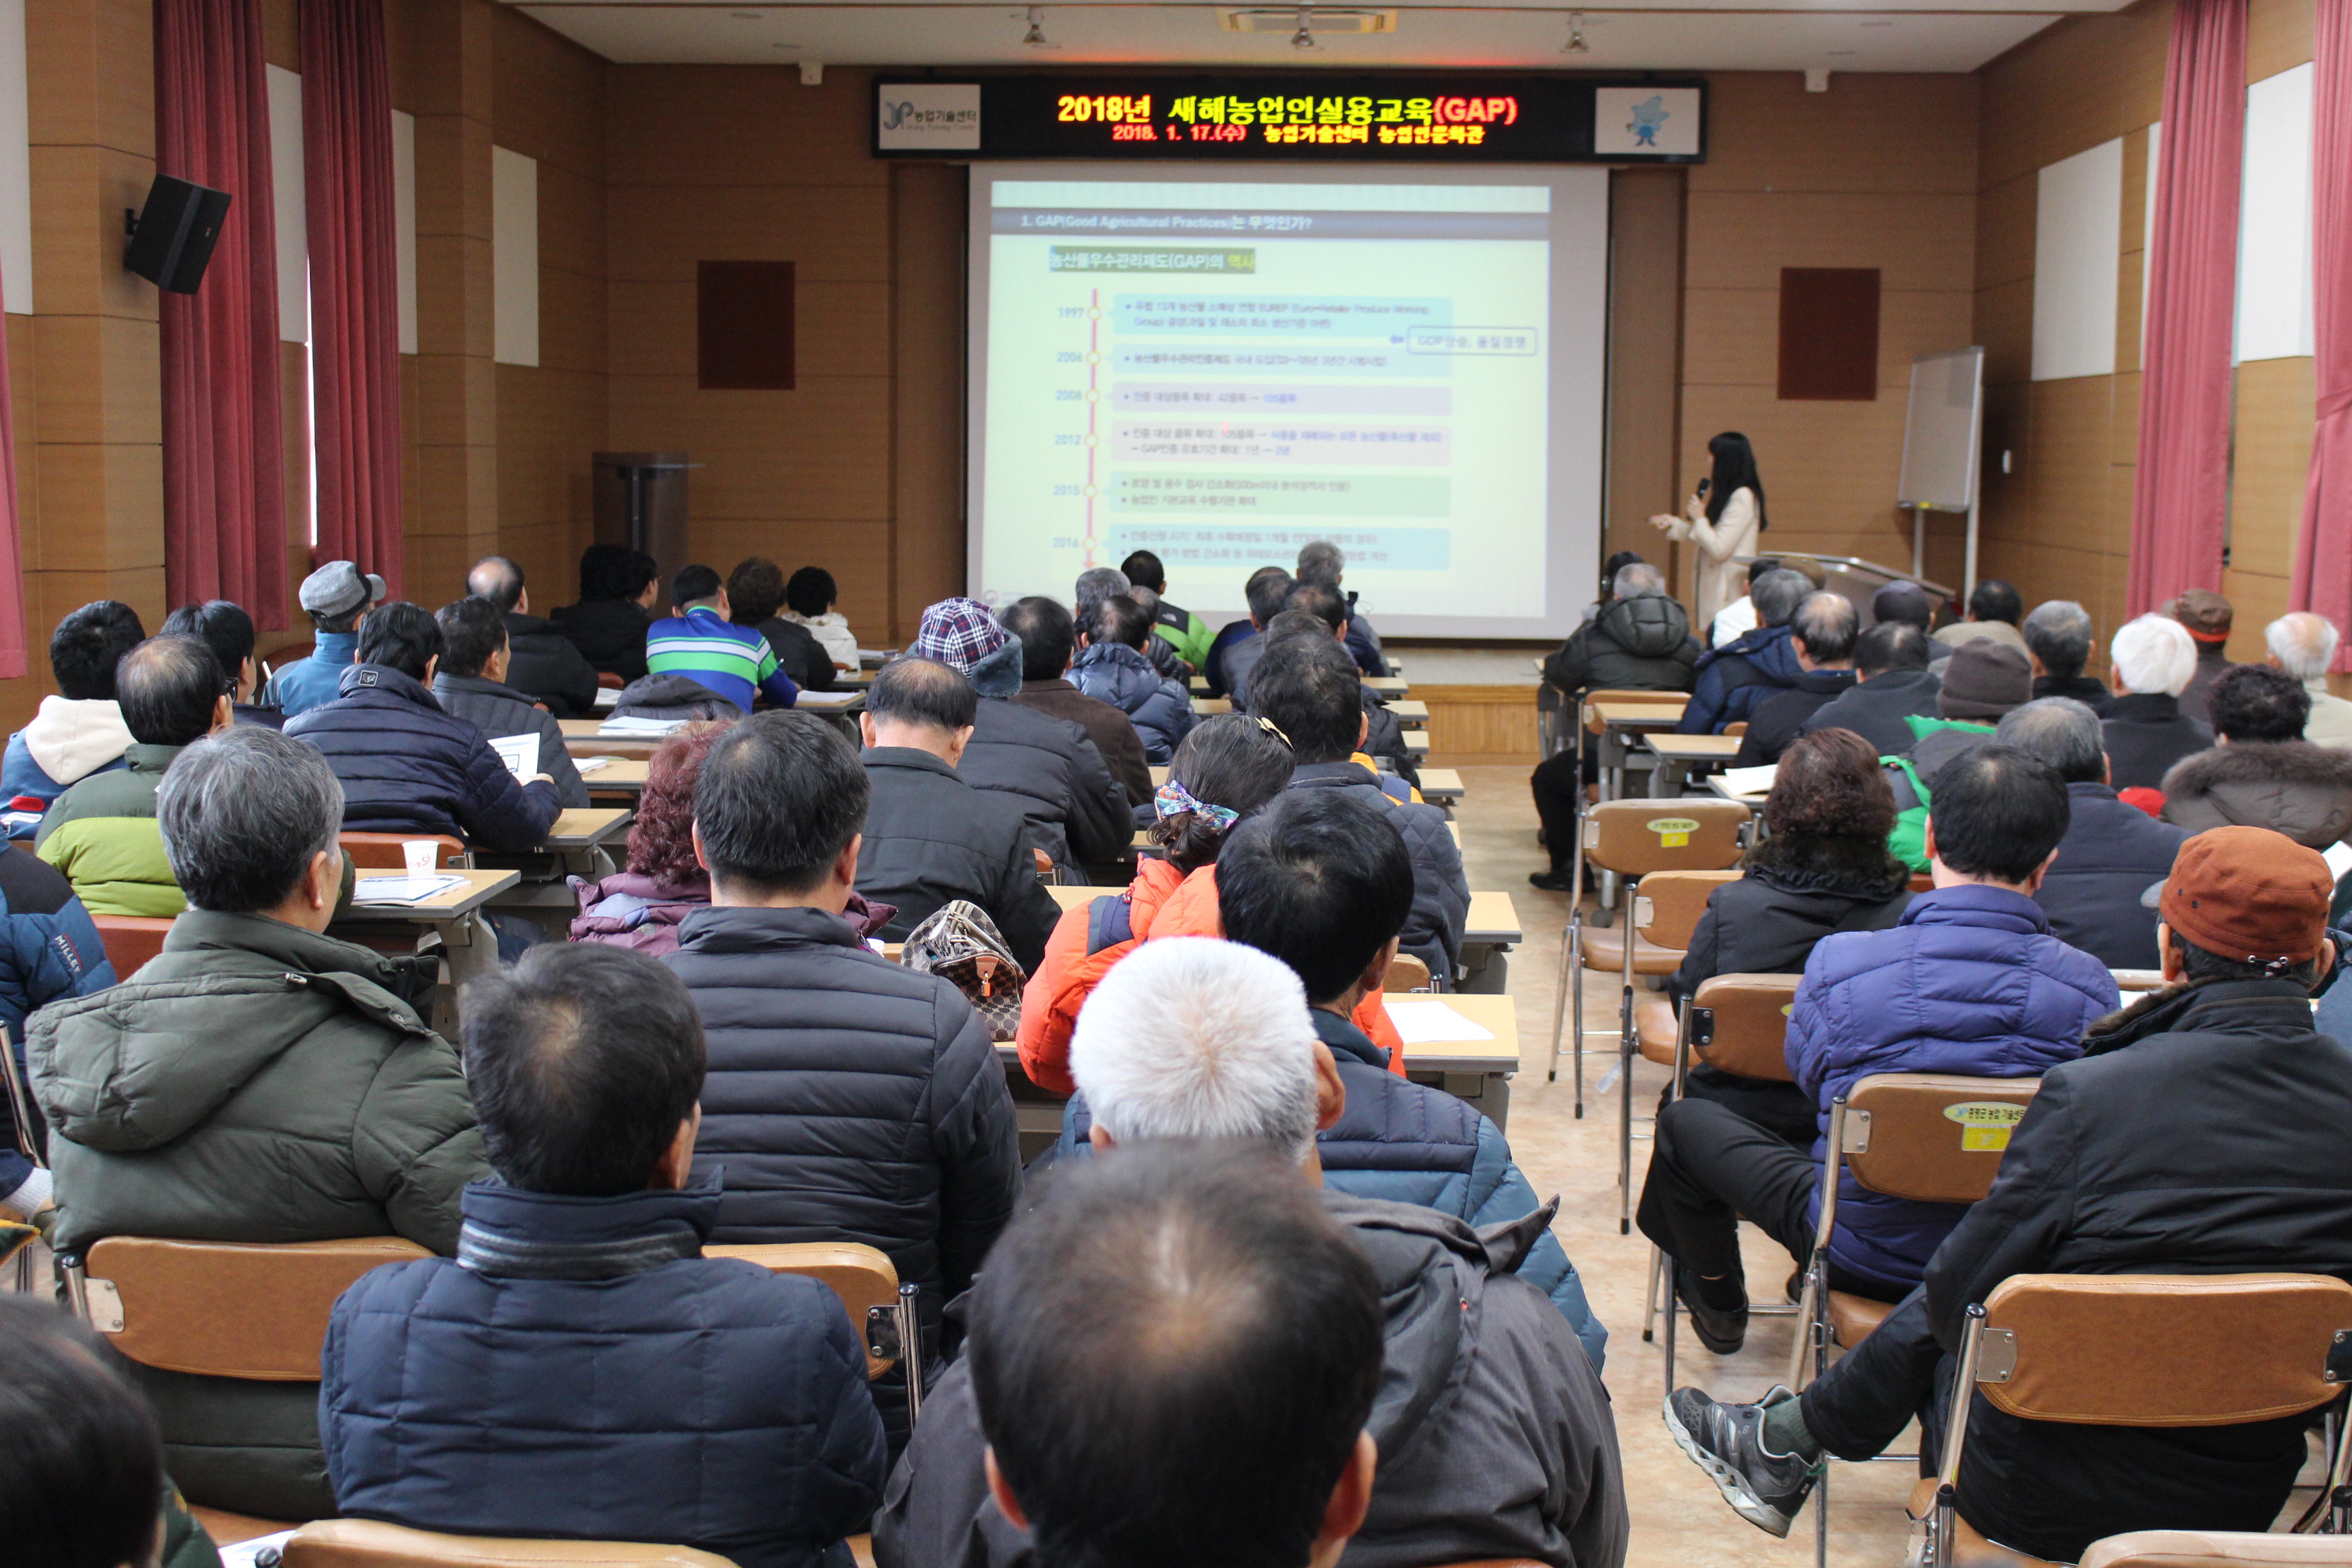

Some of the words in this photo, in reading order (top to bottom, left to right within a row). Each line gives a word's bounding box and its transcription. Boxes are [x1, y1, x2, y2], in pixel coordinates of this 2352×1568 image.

[1058, 95, 1151, 123] 2018년
[1167, 95, 1518, 125] 새해농업인실용교육(GAP)
[915, 110, 977, 122] 농업기술센터
[1113, 125, 1158, 141] 2018.
[1166, 125, 1182, 141] 1.
[1190, 124, 1247, 142] 17.(수)
[1264, 125, 1369, 144] 농업기술센터
[1377, 125, 1485, 144] 농업인문화관
[1022, 216, 1033, 227] 1.
[1035, 216, 1098, 229] GAP(Good
[1100, 216, 1169, 230] Agricultural
[1248, 216, 1312, 231] 무엇인가?
[1058, 308, 1084, 318] 1997
[1057, 353, 1083, 363] 2006
[1056, 391, 1082, 401] 2008
[1055, 434, 1081, 445] 2012
[1054, 485, 1080, 496] 2015
[1053, 538, 1079, 549] 2016
